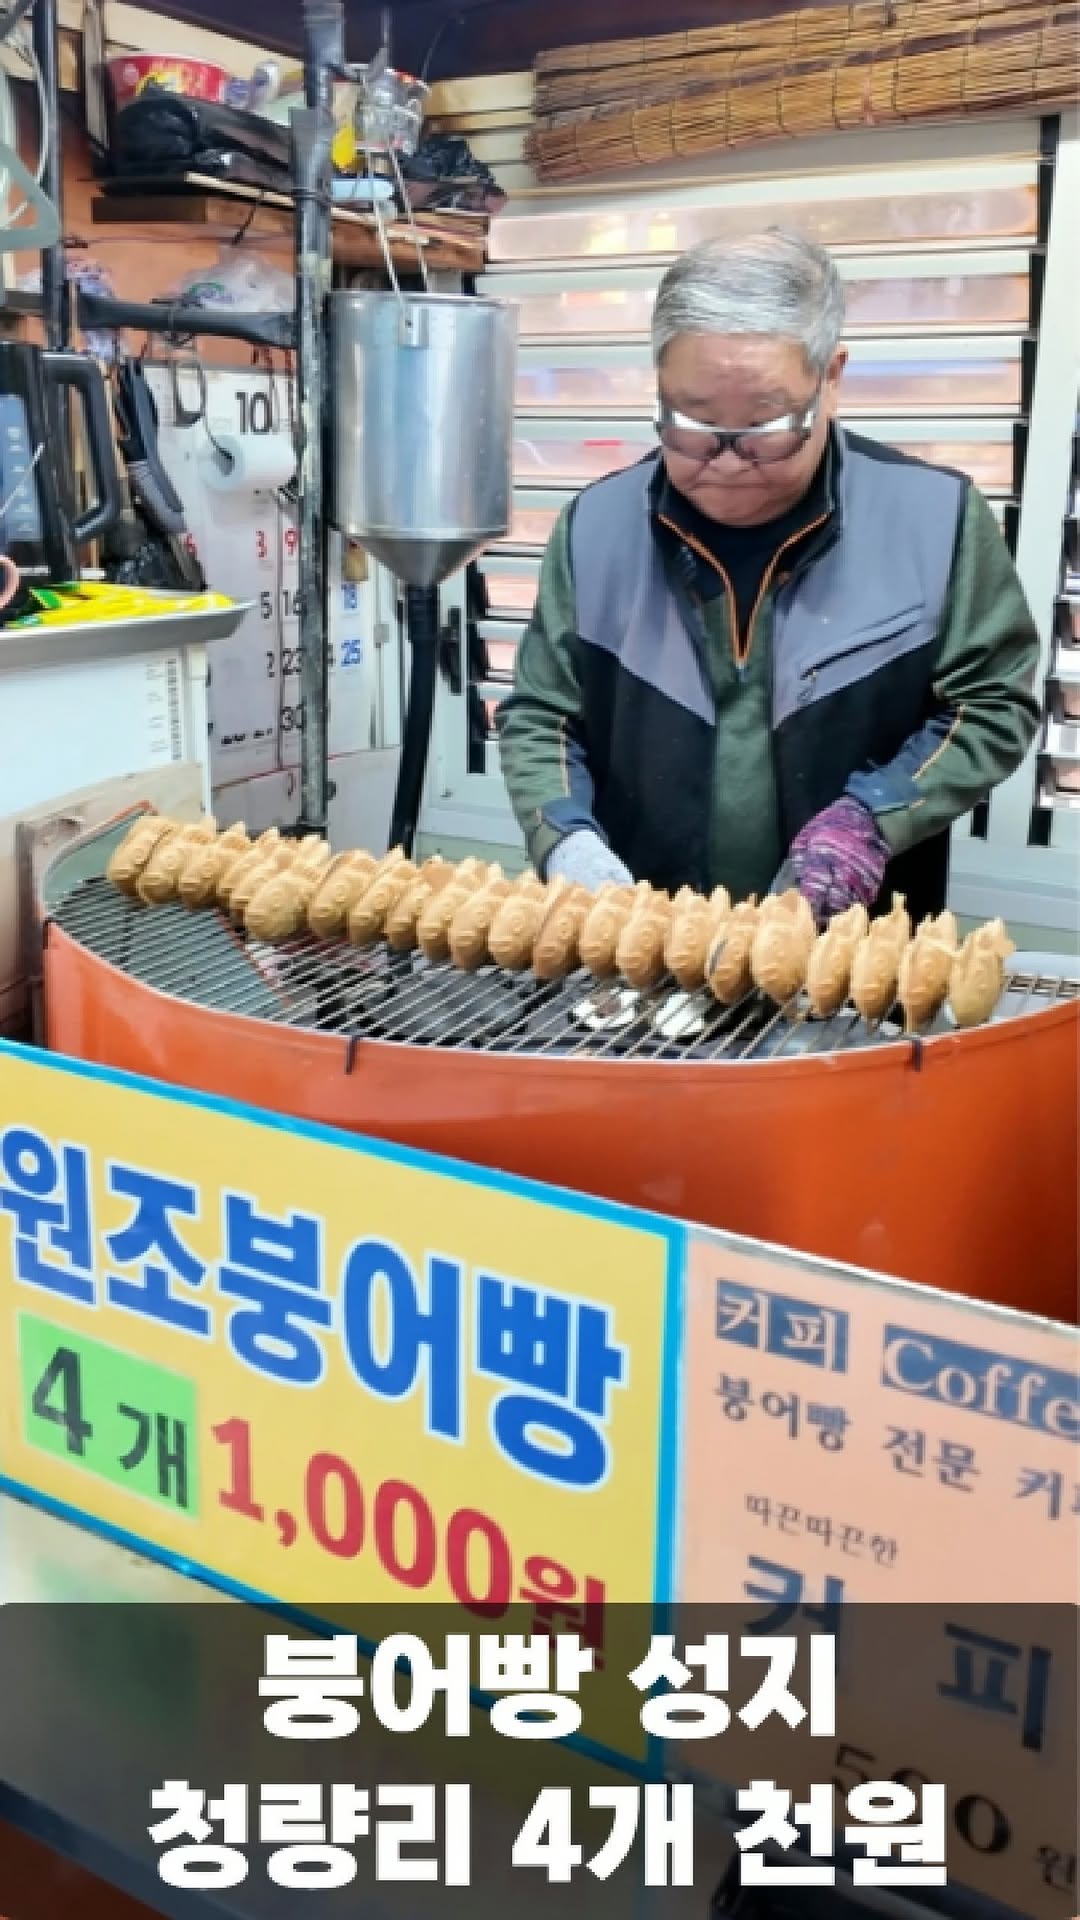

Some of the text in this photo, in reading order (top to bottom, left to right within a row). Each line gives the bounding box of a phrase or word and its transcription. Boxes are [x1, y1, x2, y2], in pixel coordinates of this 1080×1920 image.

[235, 391, 273, 434] 10
[0, 1128, 624, 1489] 원조붕어빵
[718, 1290, 838, 1373] 커피
[714, 1373, 1080, 1521] 붕어빵 전문 커
